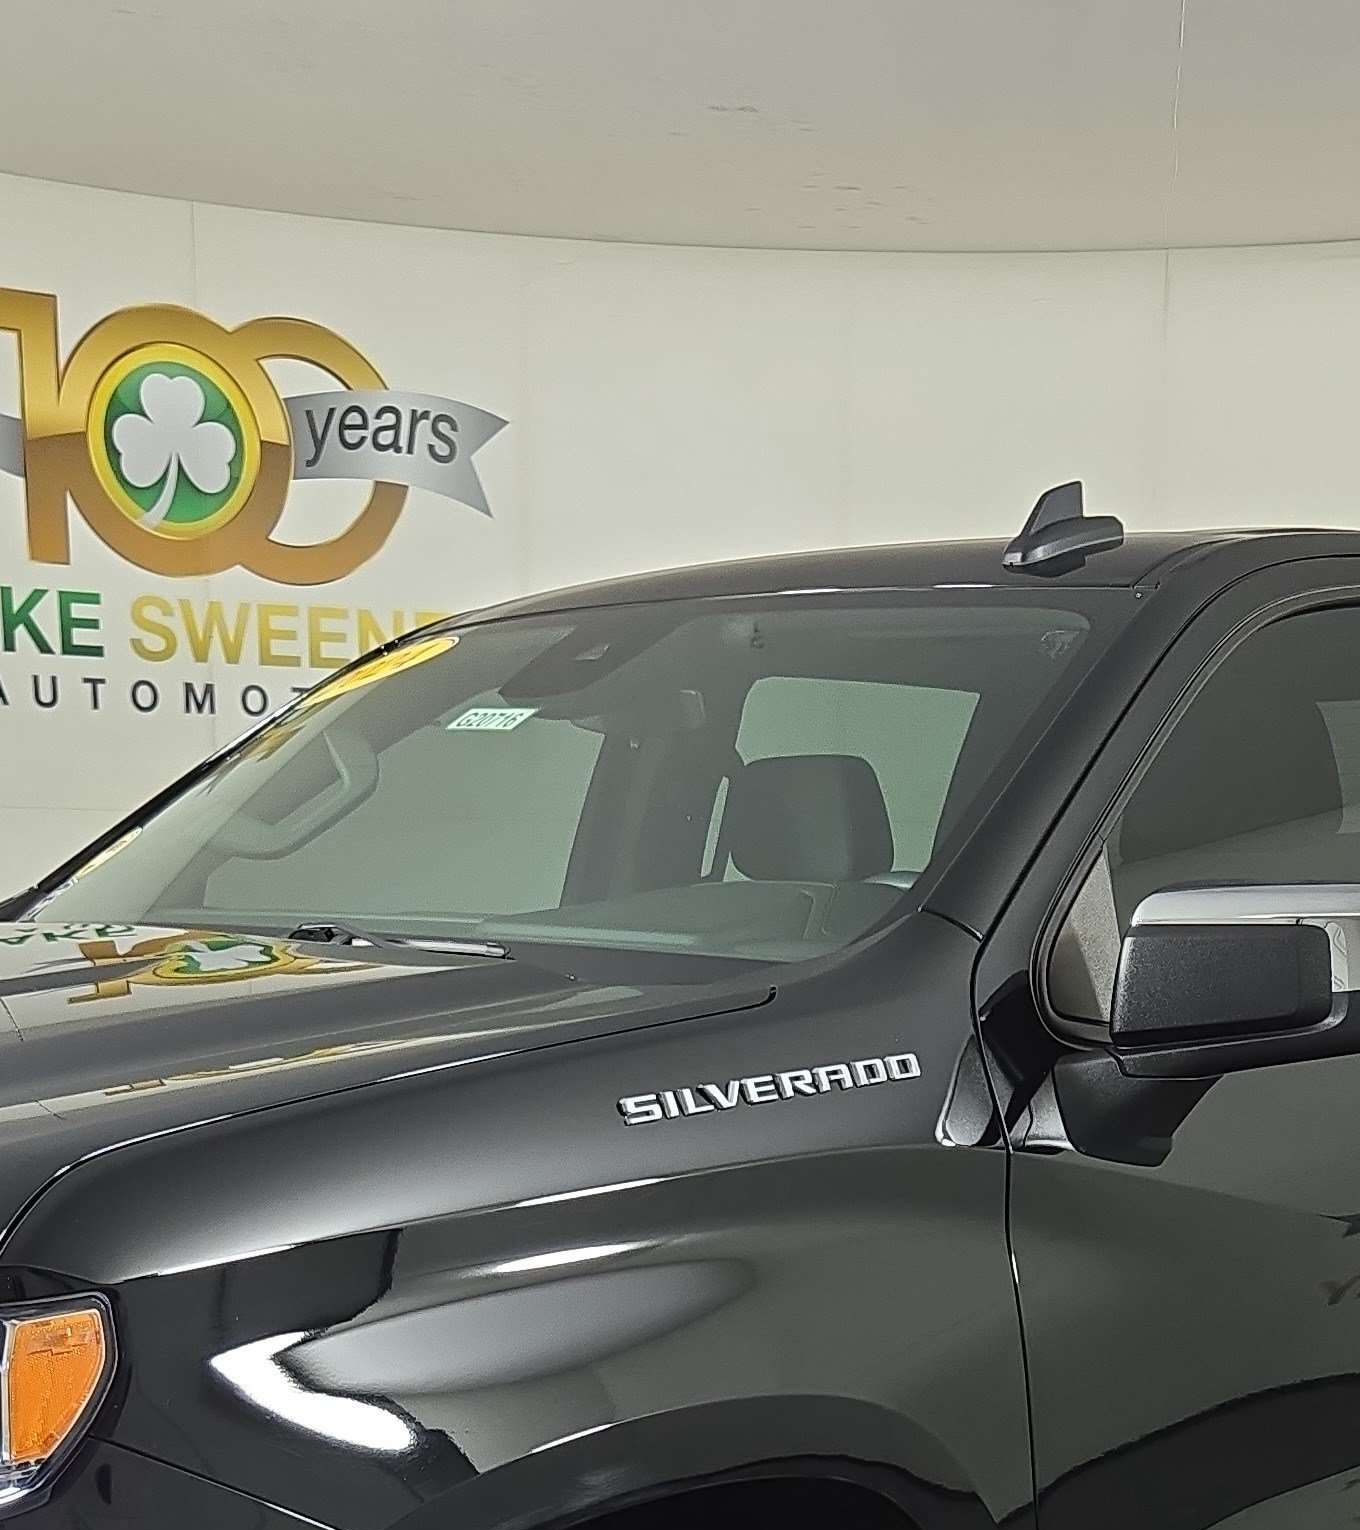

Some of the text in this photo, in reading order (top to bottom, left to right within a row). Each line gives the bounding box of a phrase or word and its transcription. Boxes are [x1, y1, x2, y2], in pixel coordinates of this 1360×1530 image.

[304, 404, 460, 468] years
[128, 594, 455, 670] SWEEN
[616, 1052, 922, 1126] SILVERADO
